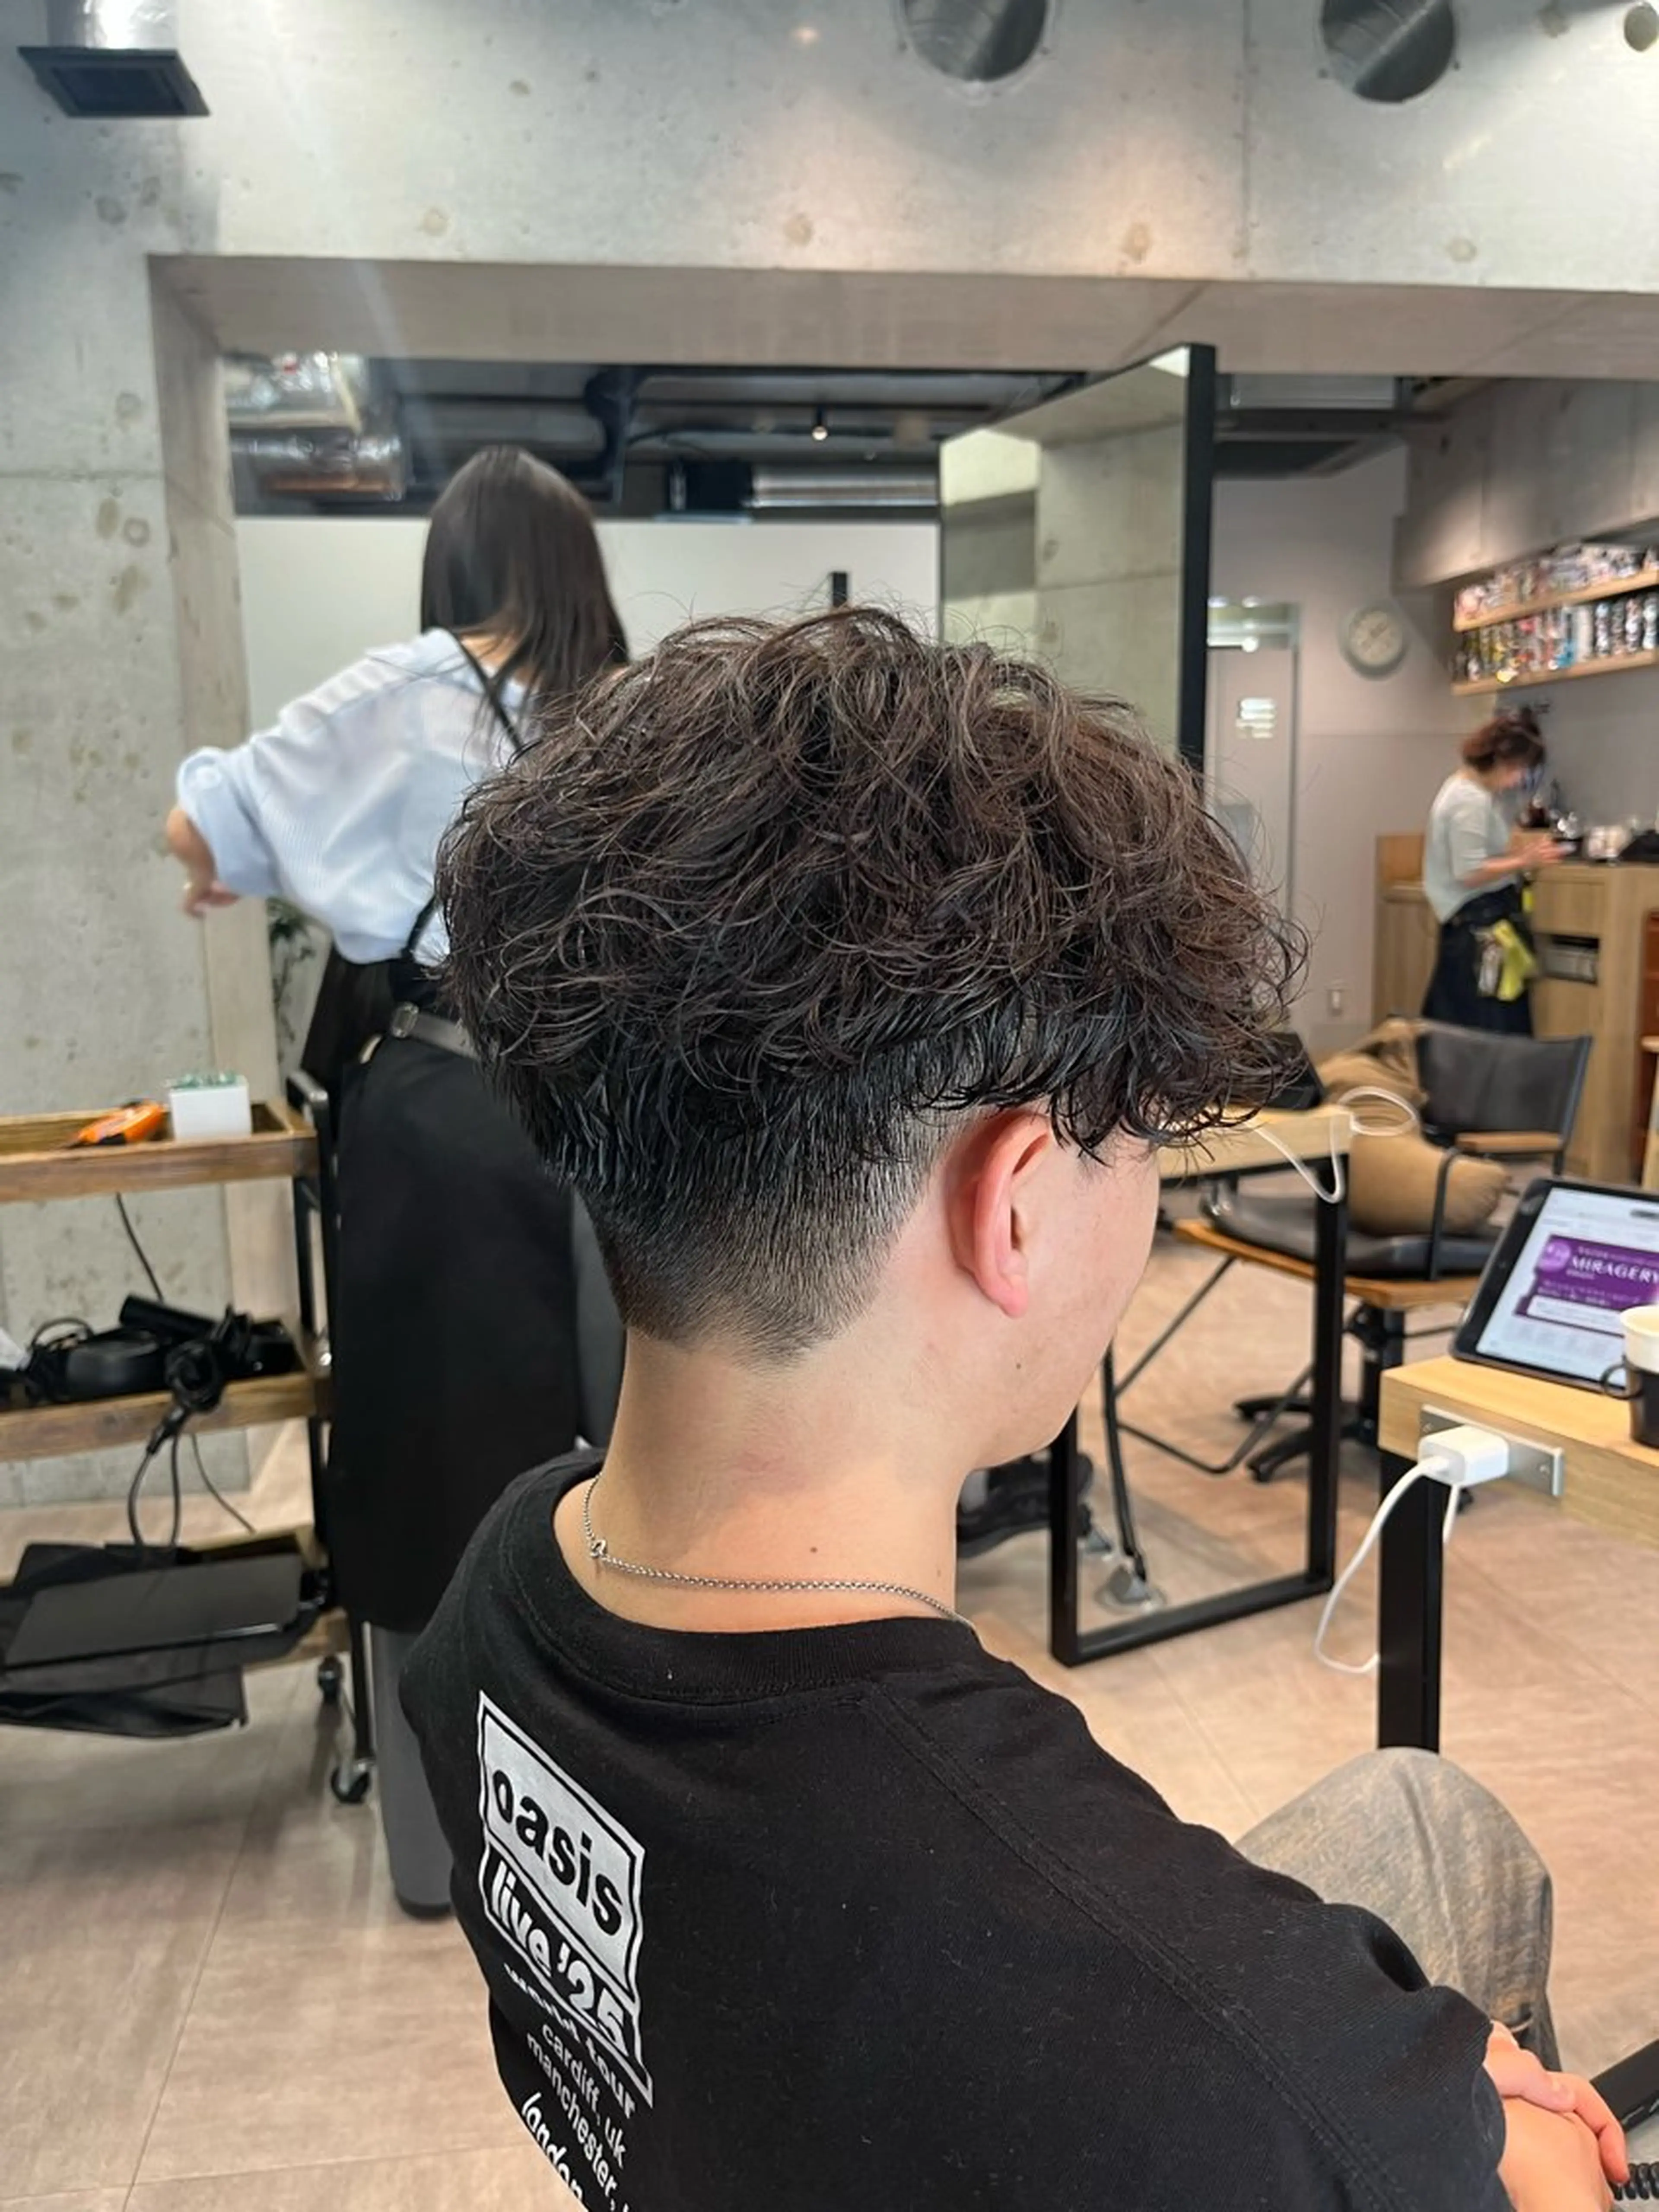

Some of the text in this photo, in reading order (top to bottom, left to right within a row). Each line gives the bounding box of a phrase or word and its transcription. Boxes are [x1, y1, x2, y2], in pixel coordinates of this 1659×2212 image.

[493, 1770, 623, 1936] oasis
[491, 1859, 551, 1978] live
[585, 2036, 636, 2119] tour
[605, 2117, 626, 2170] uk
